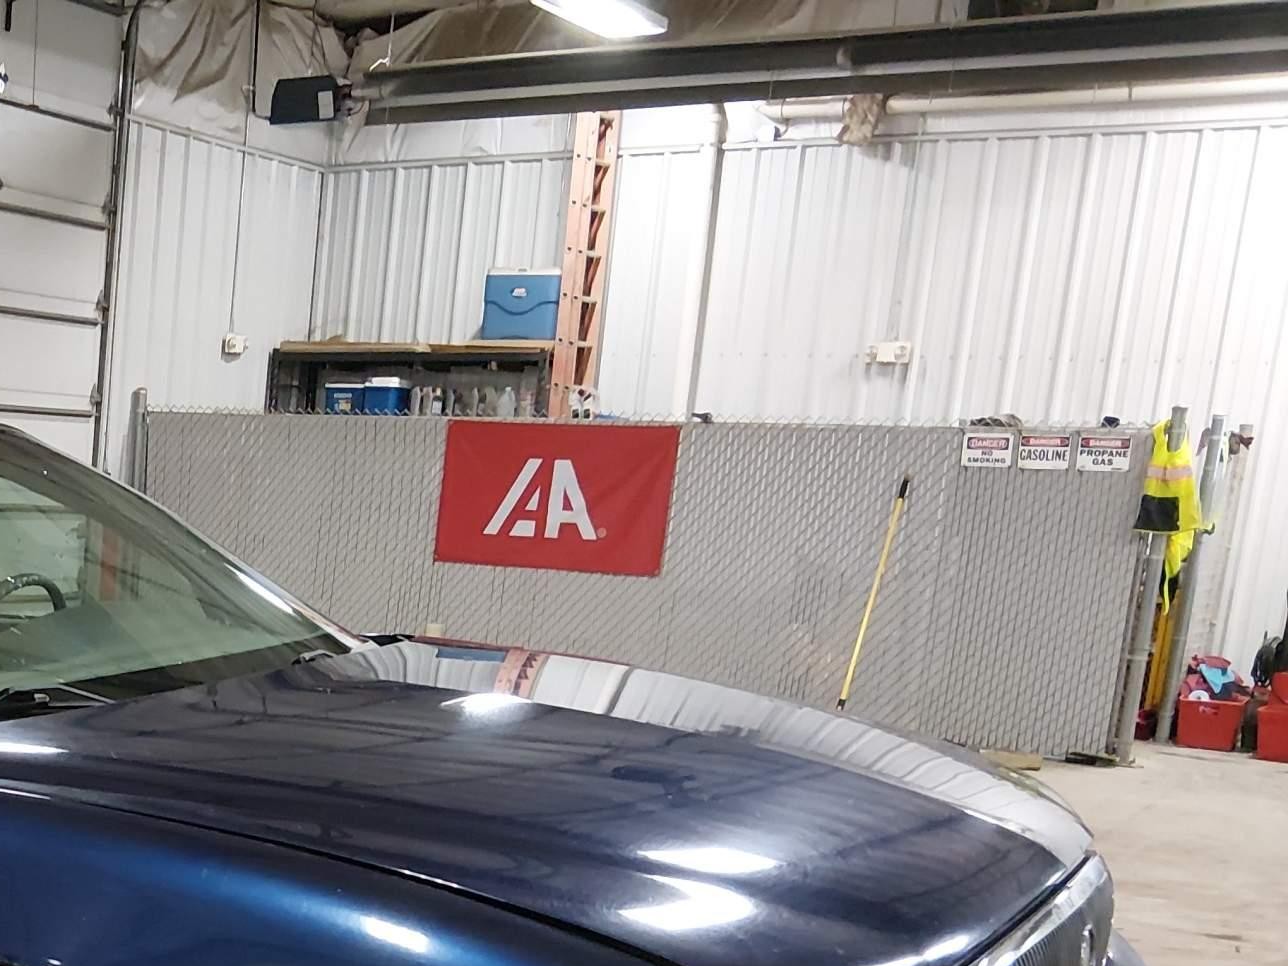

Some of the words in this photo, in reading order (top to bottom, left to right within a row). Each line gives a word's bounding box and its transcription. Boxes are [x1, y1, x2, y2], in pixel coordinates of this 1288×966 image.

[971, 438, 1006, 448] DANGER
[1019, 448, 1068, 462] GASOLINE
[1079, 449, 1129, 458] PROPANE
[1092, 458, 1114, 466] GAS
